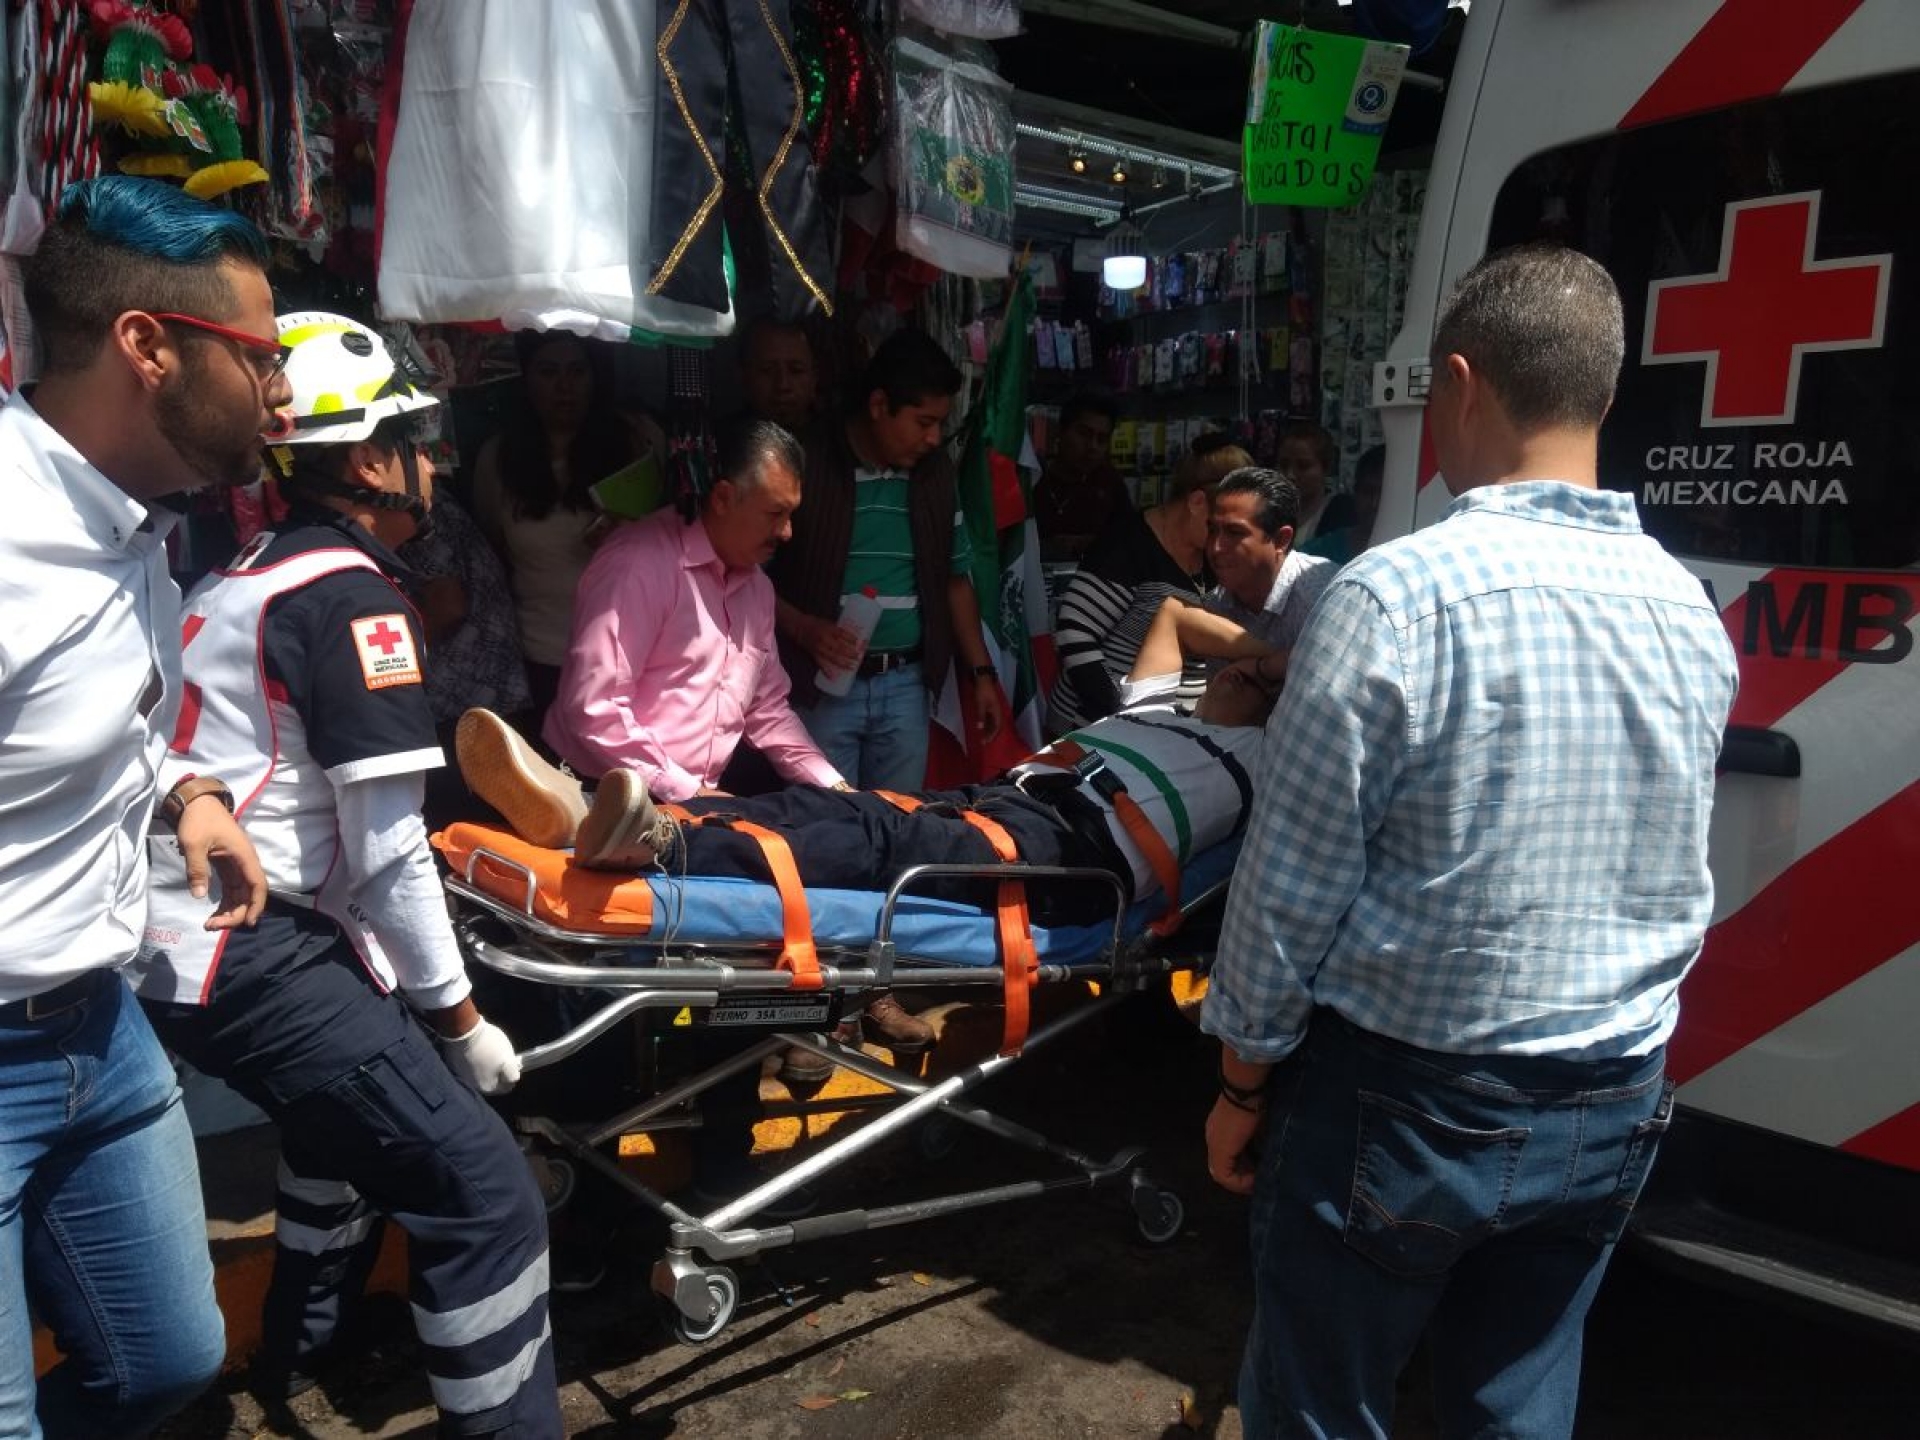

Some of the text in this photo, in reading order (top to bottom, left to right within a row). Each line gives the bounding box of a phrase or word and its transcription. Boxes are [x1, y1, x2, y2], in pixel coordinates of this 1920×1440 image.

[1645, 441, 1854, 471] CRUZ ROJA
[1642, 479, 1849, 505] MEXICANA
[1700, 578, 1914, 665] MB
[715, 1010, 748, 1022] FERNO
